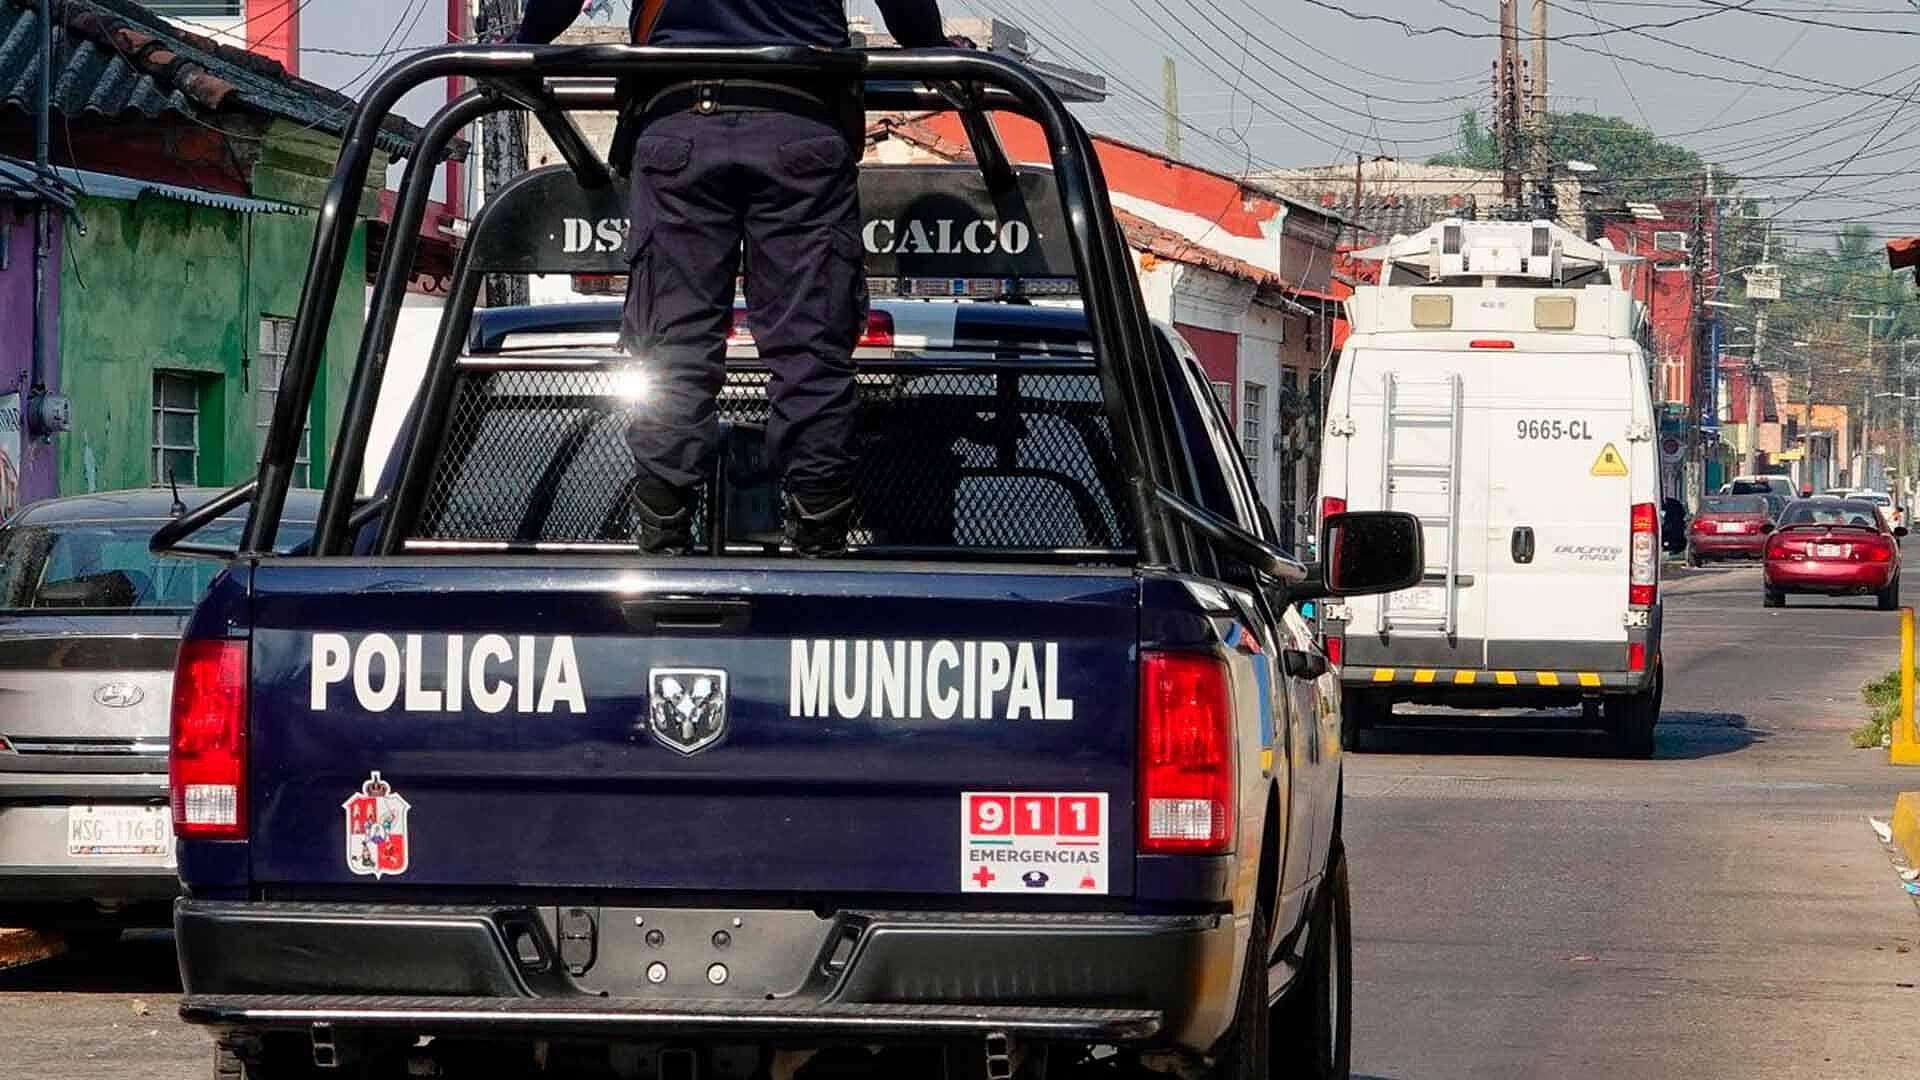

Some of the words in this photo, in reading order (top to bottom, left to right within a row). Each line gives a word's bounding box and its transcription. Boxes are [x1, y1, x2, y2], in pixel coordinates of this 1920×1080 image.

[1517, 419, 1592, 440] 9665-CL
[310, 633, 587, 713] POLICIA
[789, 639, 1073, 719] MUNICIPAL
[969, 849, 1101, 864] EMERGENCIAS
